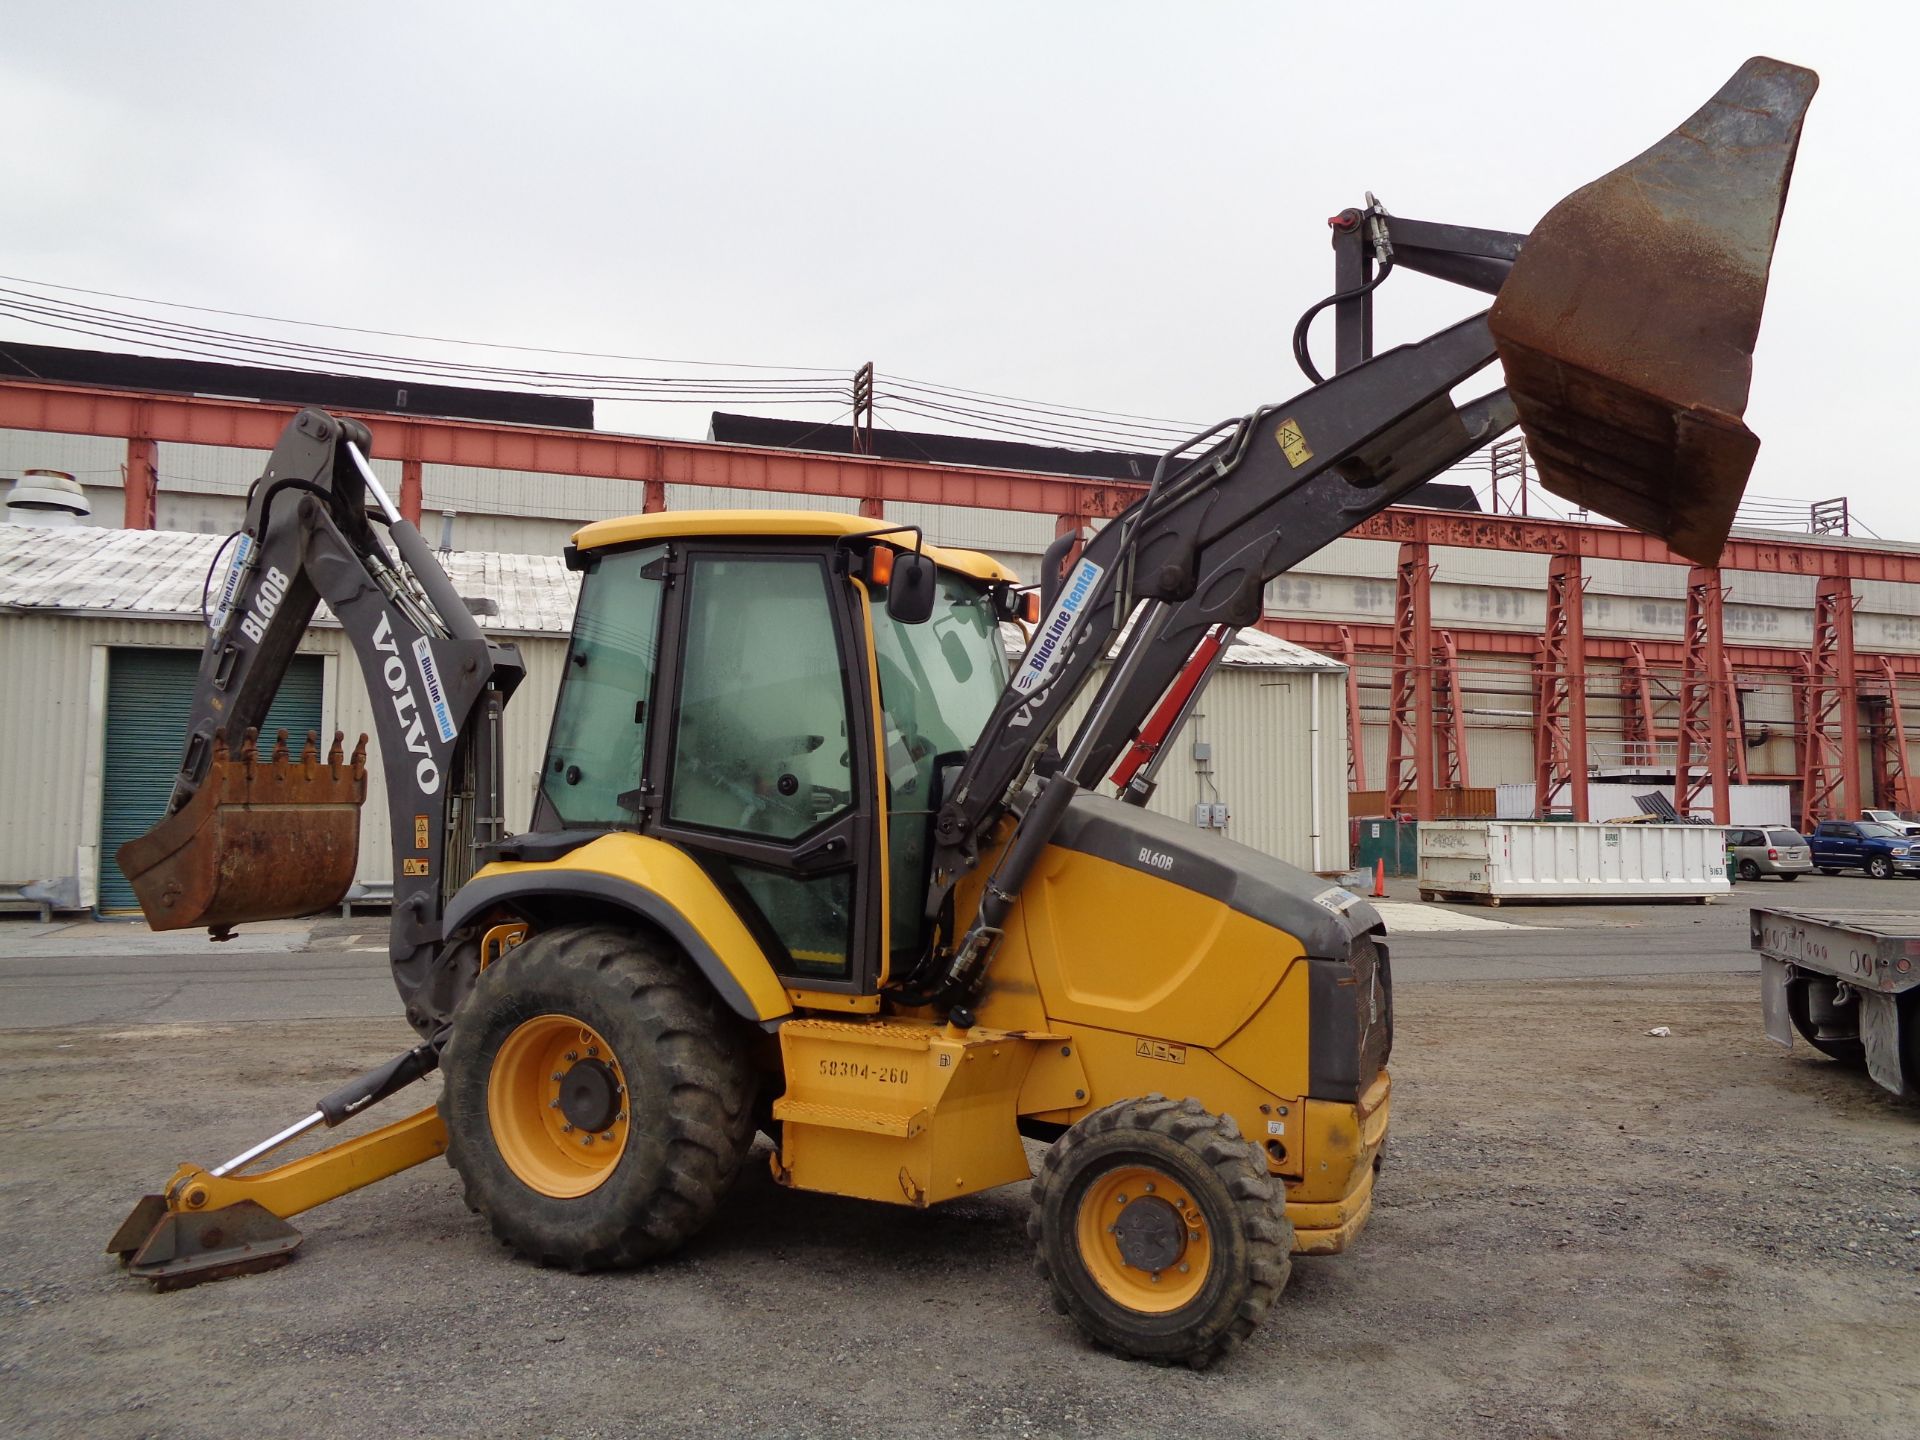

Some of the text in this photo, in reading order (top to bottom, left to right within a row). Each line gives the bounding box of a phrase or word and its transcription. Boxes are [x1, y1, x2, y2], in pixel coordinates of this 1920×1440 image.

[219, 570, 239, 613] BlueLine
[240, 566, 289, 645] BL60B
[1029, 563, 1097, 672] BlueLine Rental
[372, 609, 440, 795] VOLVO
[420, 656, 455, 740] BlueLine Rental
[1138, 847, 1174, 870] BL60B
[819, 1060, 909, 1085] 58304-260
